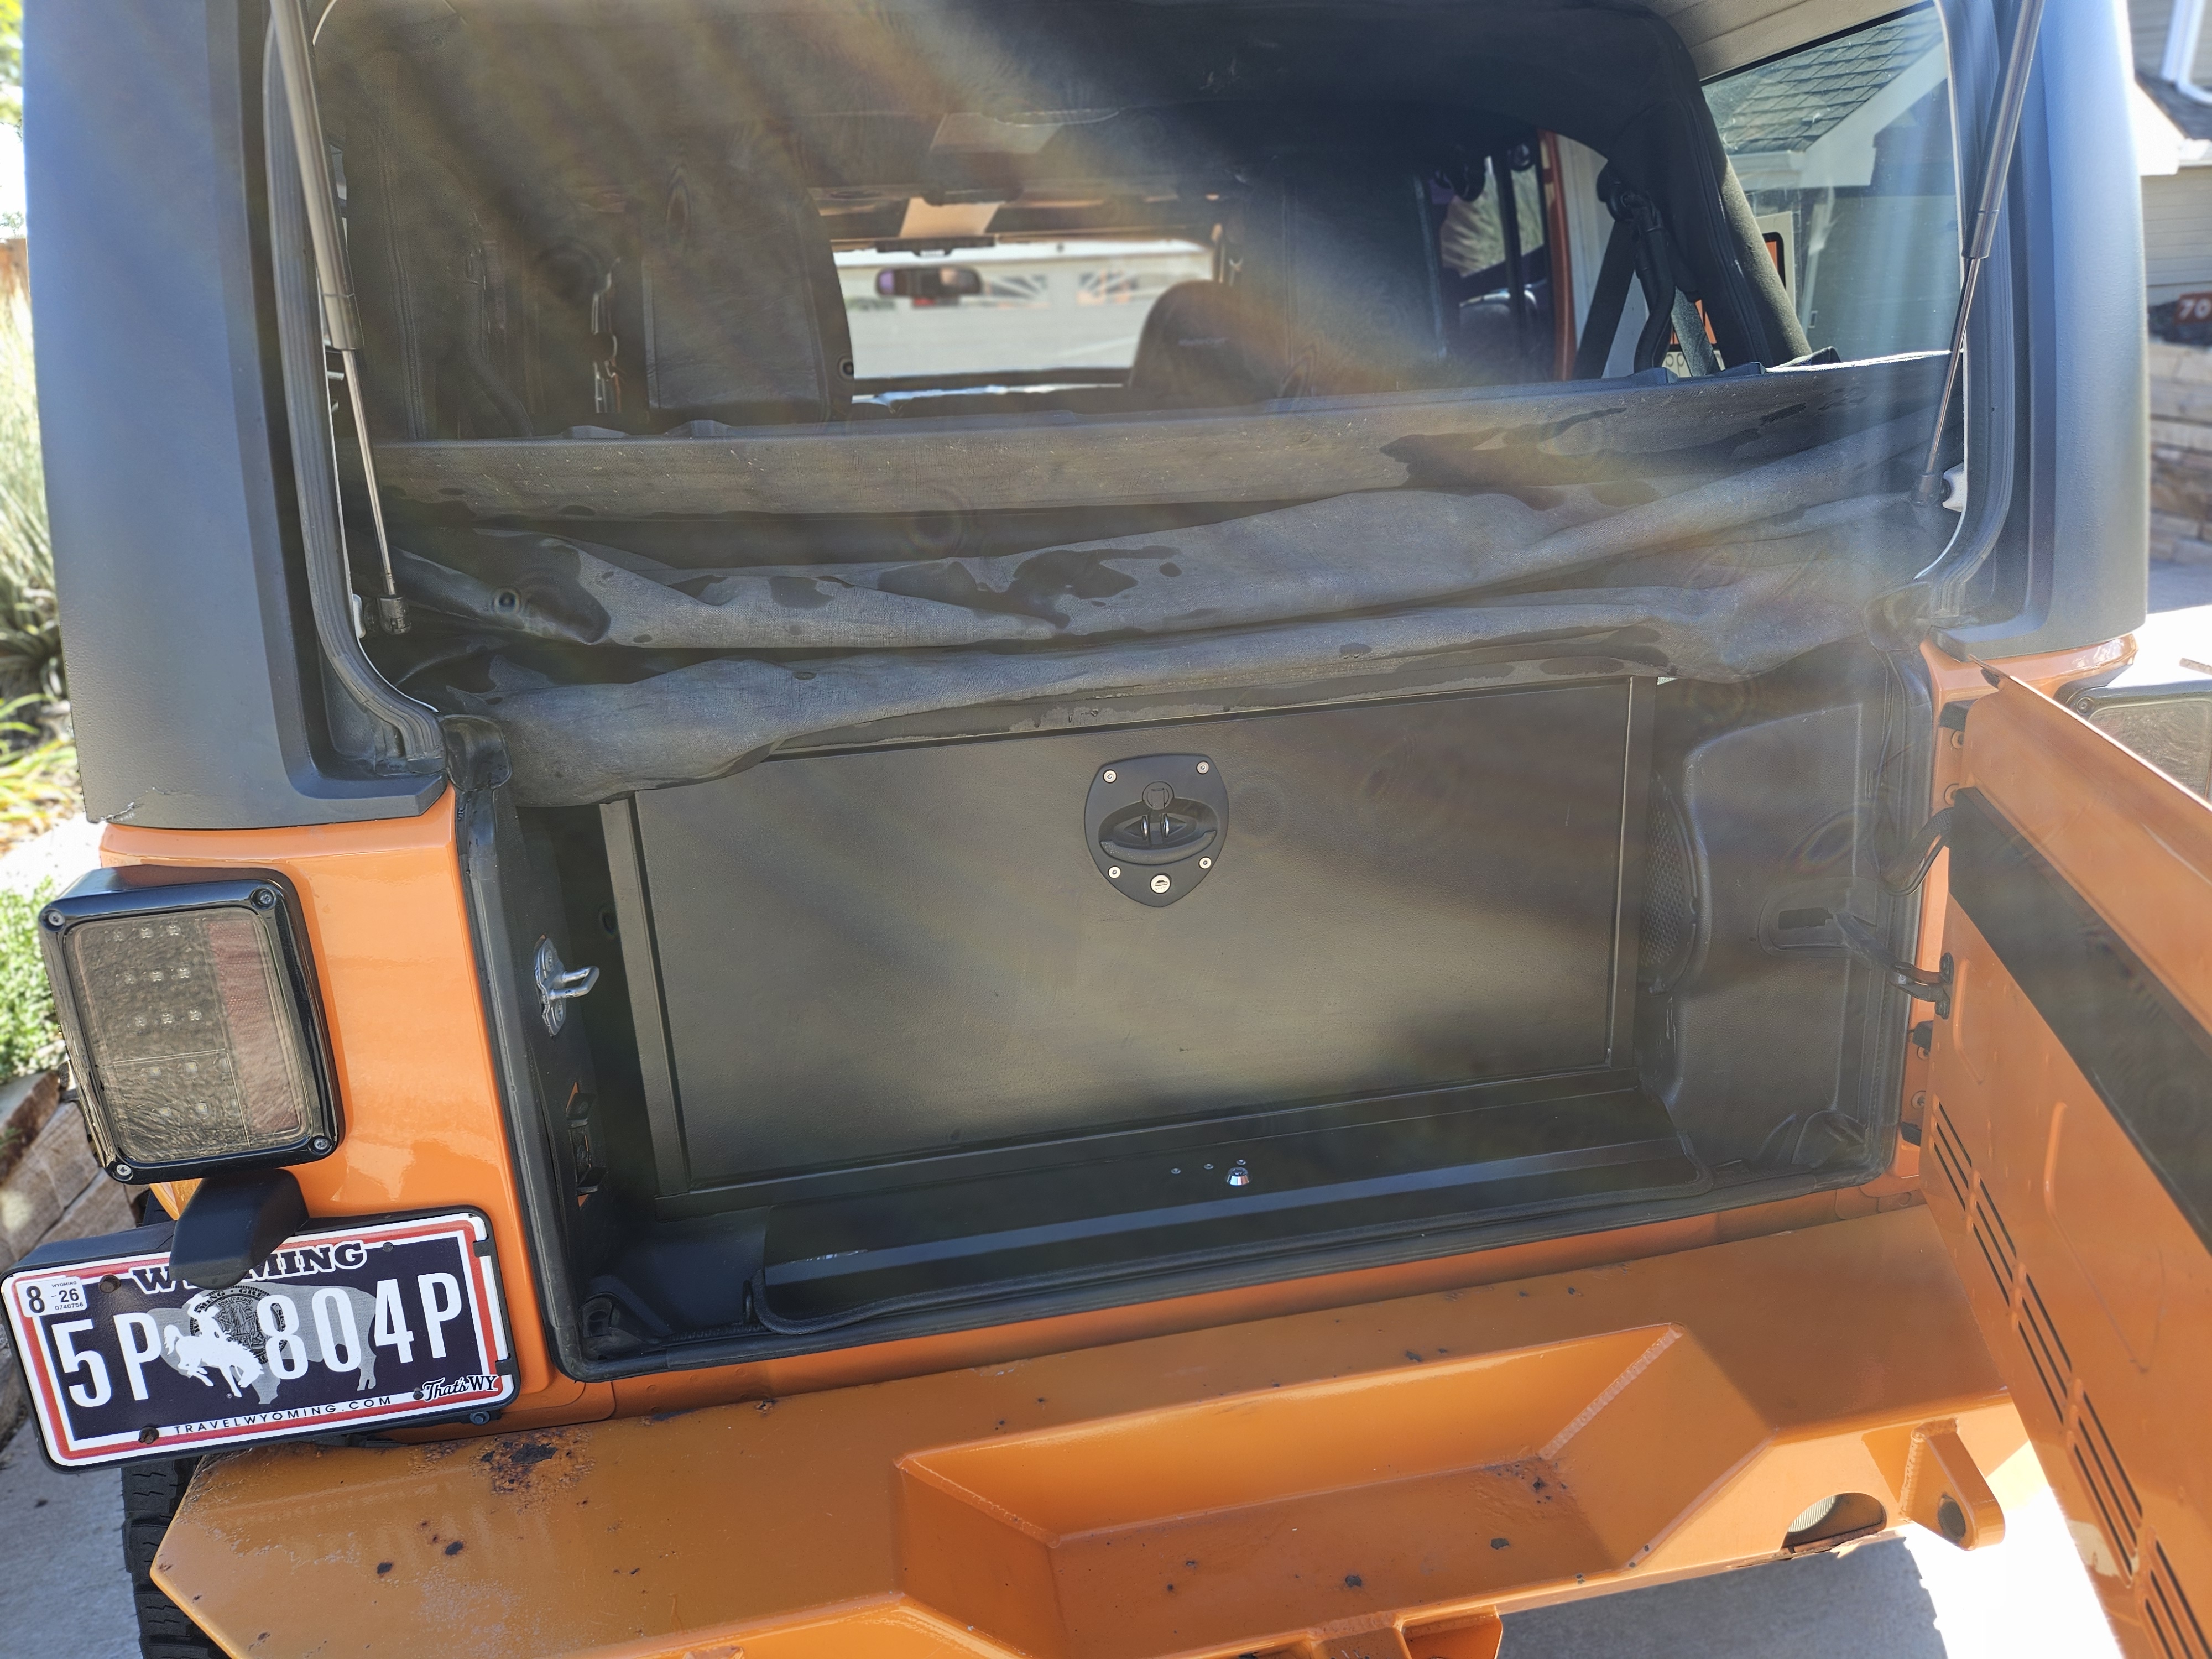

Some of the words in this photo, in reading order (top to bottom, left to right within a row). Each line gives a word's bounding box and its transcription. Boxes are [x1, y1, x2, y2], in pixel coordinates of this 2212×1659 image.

[132, 1241, 364, 1293] WMING
[26, 1286, 45, 1313] 8
[174, 1396, 391, 1434] TRAVELWYOMING.COM
